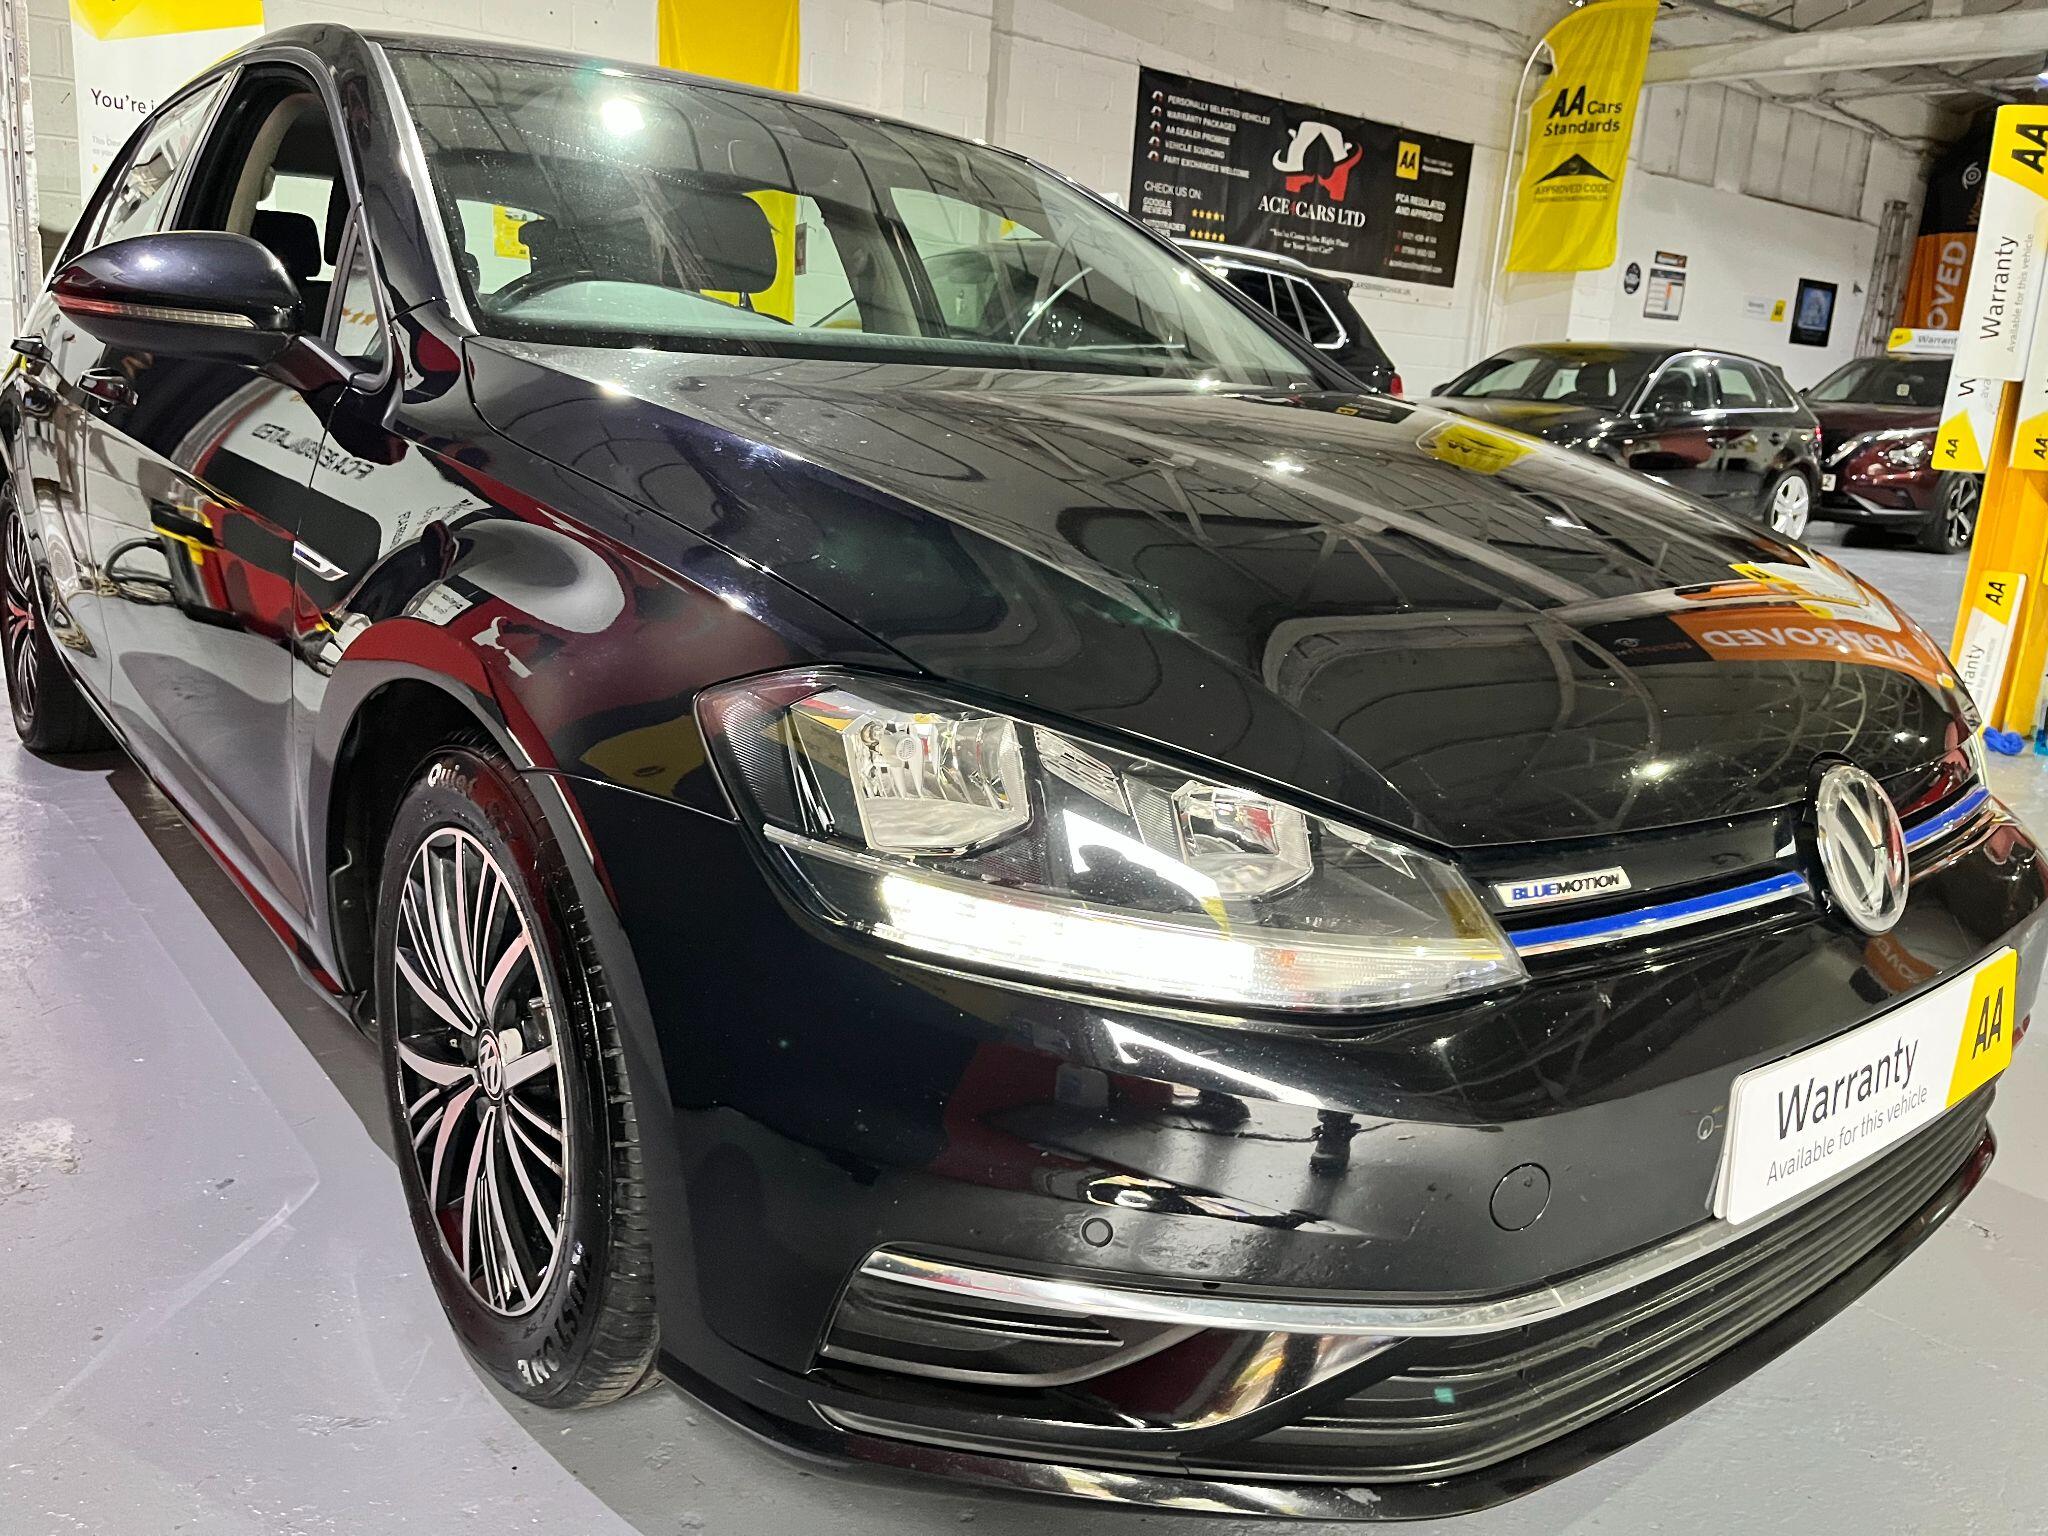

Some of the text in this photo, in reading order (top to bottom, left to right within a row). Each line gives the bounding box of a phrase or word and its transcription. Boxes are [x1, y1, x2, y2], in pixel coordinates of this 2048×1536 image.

[91, 88, 146, 114] You're
[1547, 85, 1622, 119] AA Cars
[1166, 110, 1236, 132] WARRANTY PACKAGES
[1543, 119, 1620, 137] Standards
[1399, 150, 1417, 170] AA
[2011, 124, 2048, 174] AA
[1144, 180, 1175, 195] CHECK
[1175, 186, 1188, 197] US
[1337, 208, 1366, 228] LTD
[1927, 240, 1967, 330] OVED
[1980, 236, 2018, 339] Warranty
[2006, 233, 2034, 353] Available for this vehicle
[1918, 336, 1958, 345] Warrant
[1946, 439, 1959, 460] AA
[2033, 438, 2048, 460] AA
[1985, 581, 2006, 606] AA
[1964, 644, 1985, 686] ranty
[1512, 873, 1620, 901] BLUEMOTION
[1972, 986, 2004, 1060] AA
[1778, 1036, 1919, 1141] Warranty
[1766, 1085, 1928, 1186] Available for this vehicle
